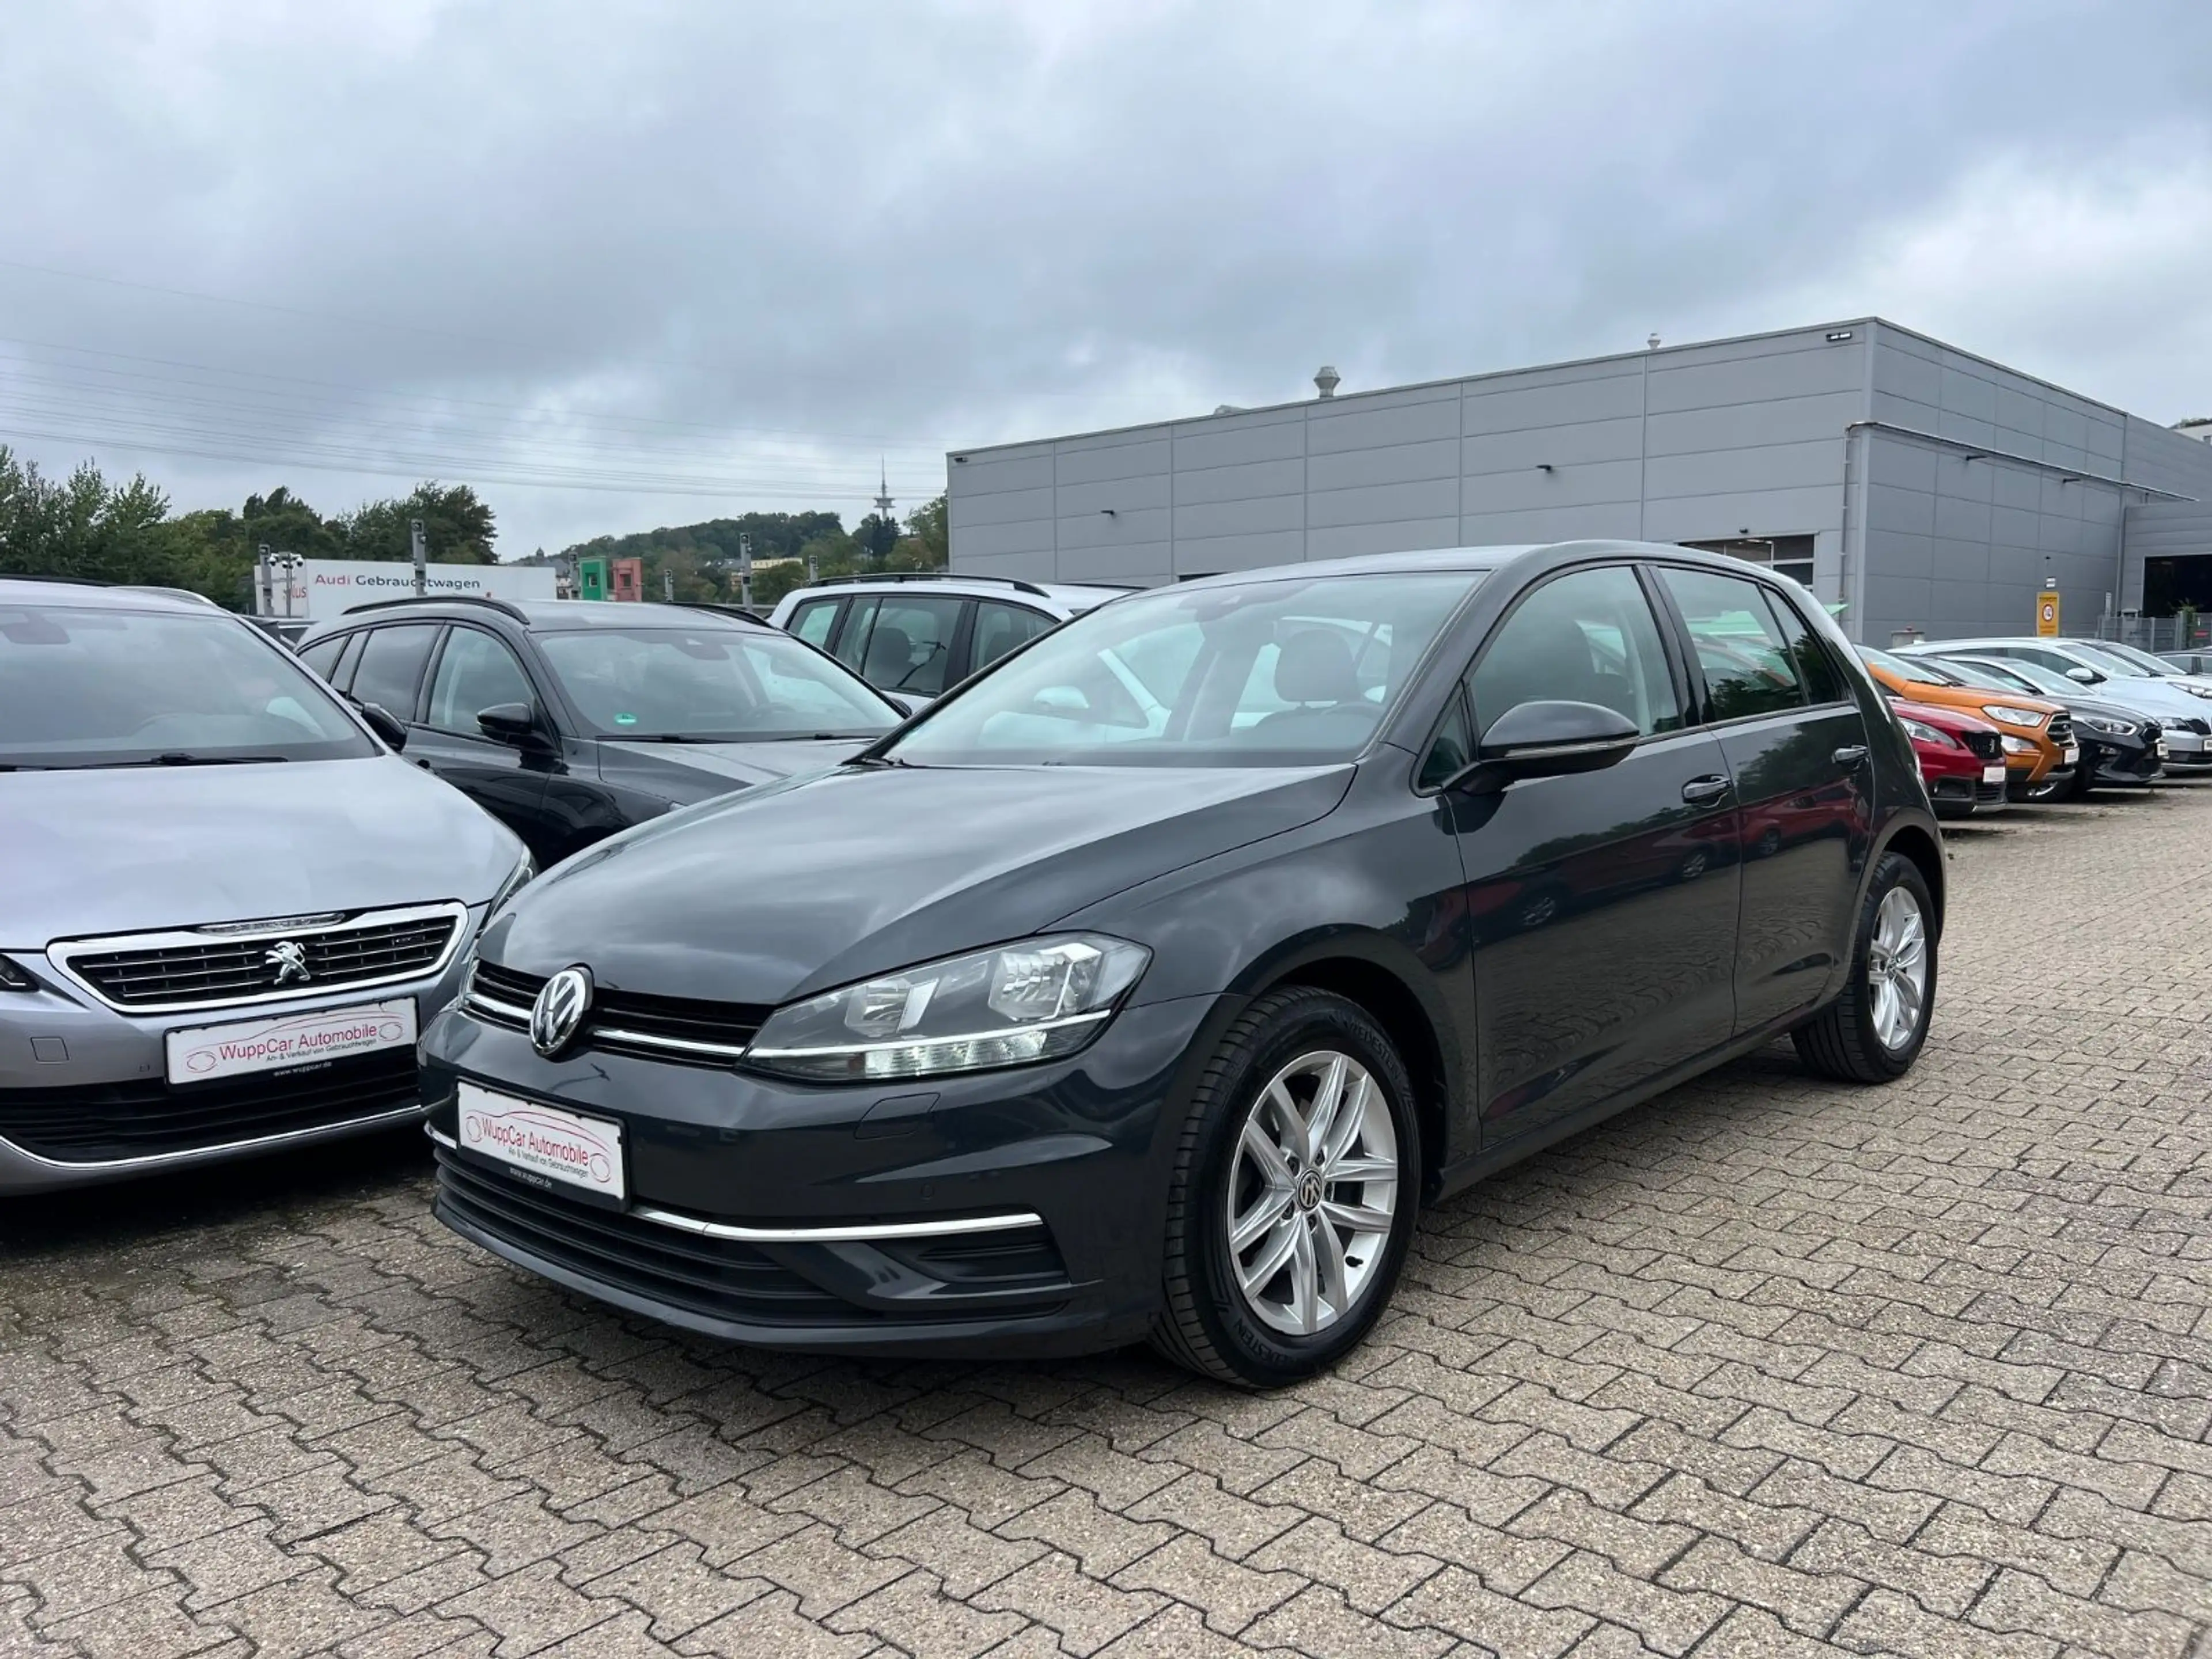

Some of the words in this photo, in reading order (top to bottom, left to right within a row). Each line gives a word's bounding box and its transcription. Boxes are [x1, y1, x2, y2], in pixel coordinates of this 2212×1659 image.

[315, 573, 350, 585] Audi
[355, 575, 480, 590] Gebrauctwagen
[219, 1038, 294, 1060] WuppCar
[298, 1024, 377, 1049] Automobile
[481, 1118, 526, 1147] WuppCar
[529, 1131, 588, 1166] Automobile
